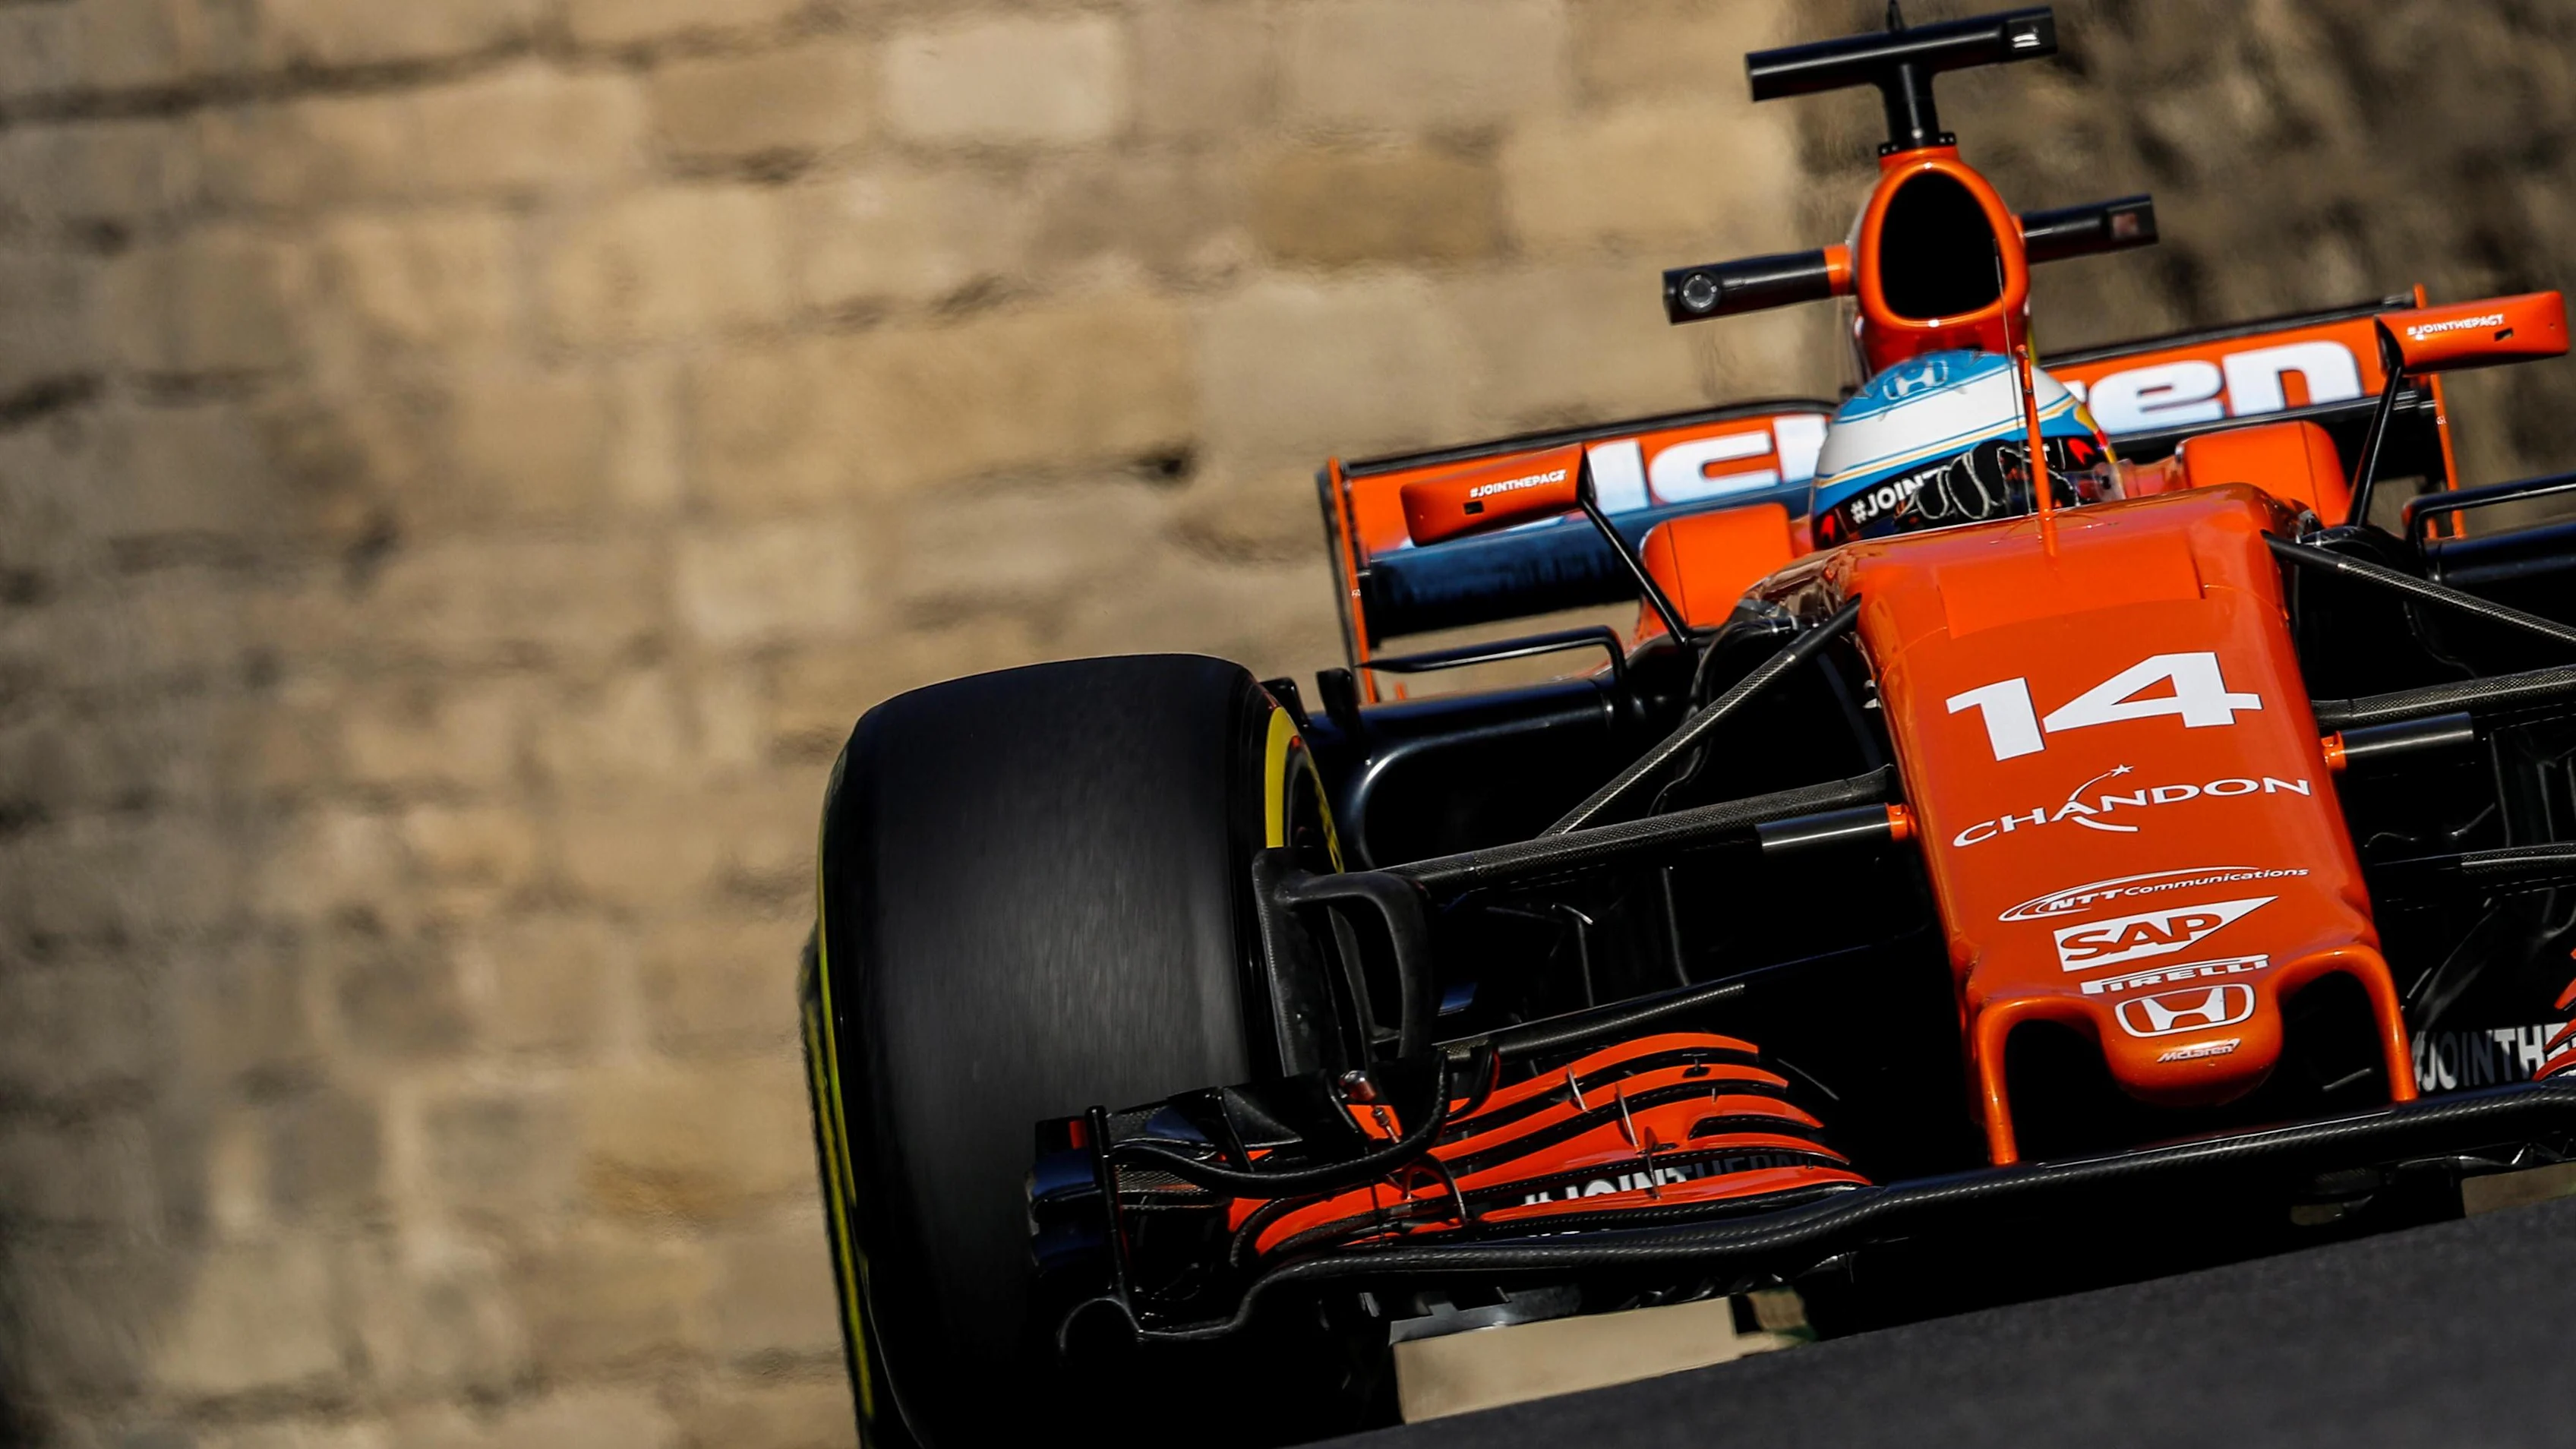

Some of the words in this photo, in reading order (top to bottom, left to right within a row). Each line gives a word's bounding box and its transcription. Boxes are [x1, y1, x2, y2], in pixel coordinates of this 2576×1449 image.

[2407, 313, 2505, 336] #JOINTHEPACT
[1470, 469, 1567, 498] #JOINTHEPACT
[1945, 651, 2263, 762] 14
[1953, 776, 2311, 848] CHANDON
[2060, 913, 2223, 961] SAP
[2080, 954, 2270, 995] PIRELLI
[2157, 1044, 2236, 1063] McLaren
